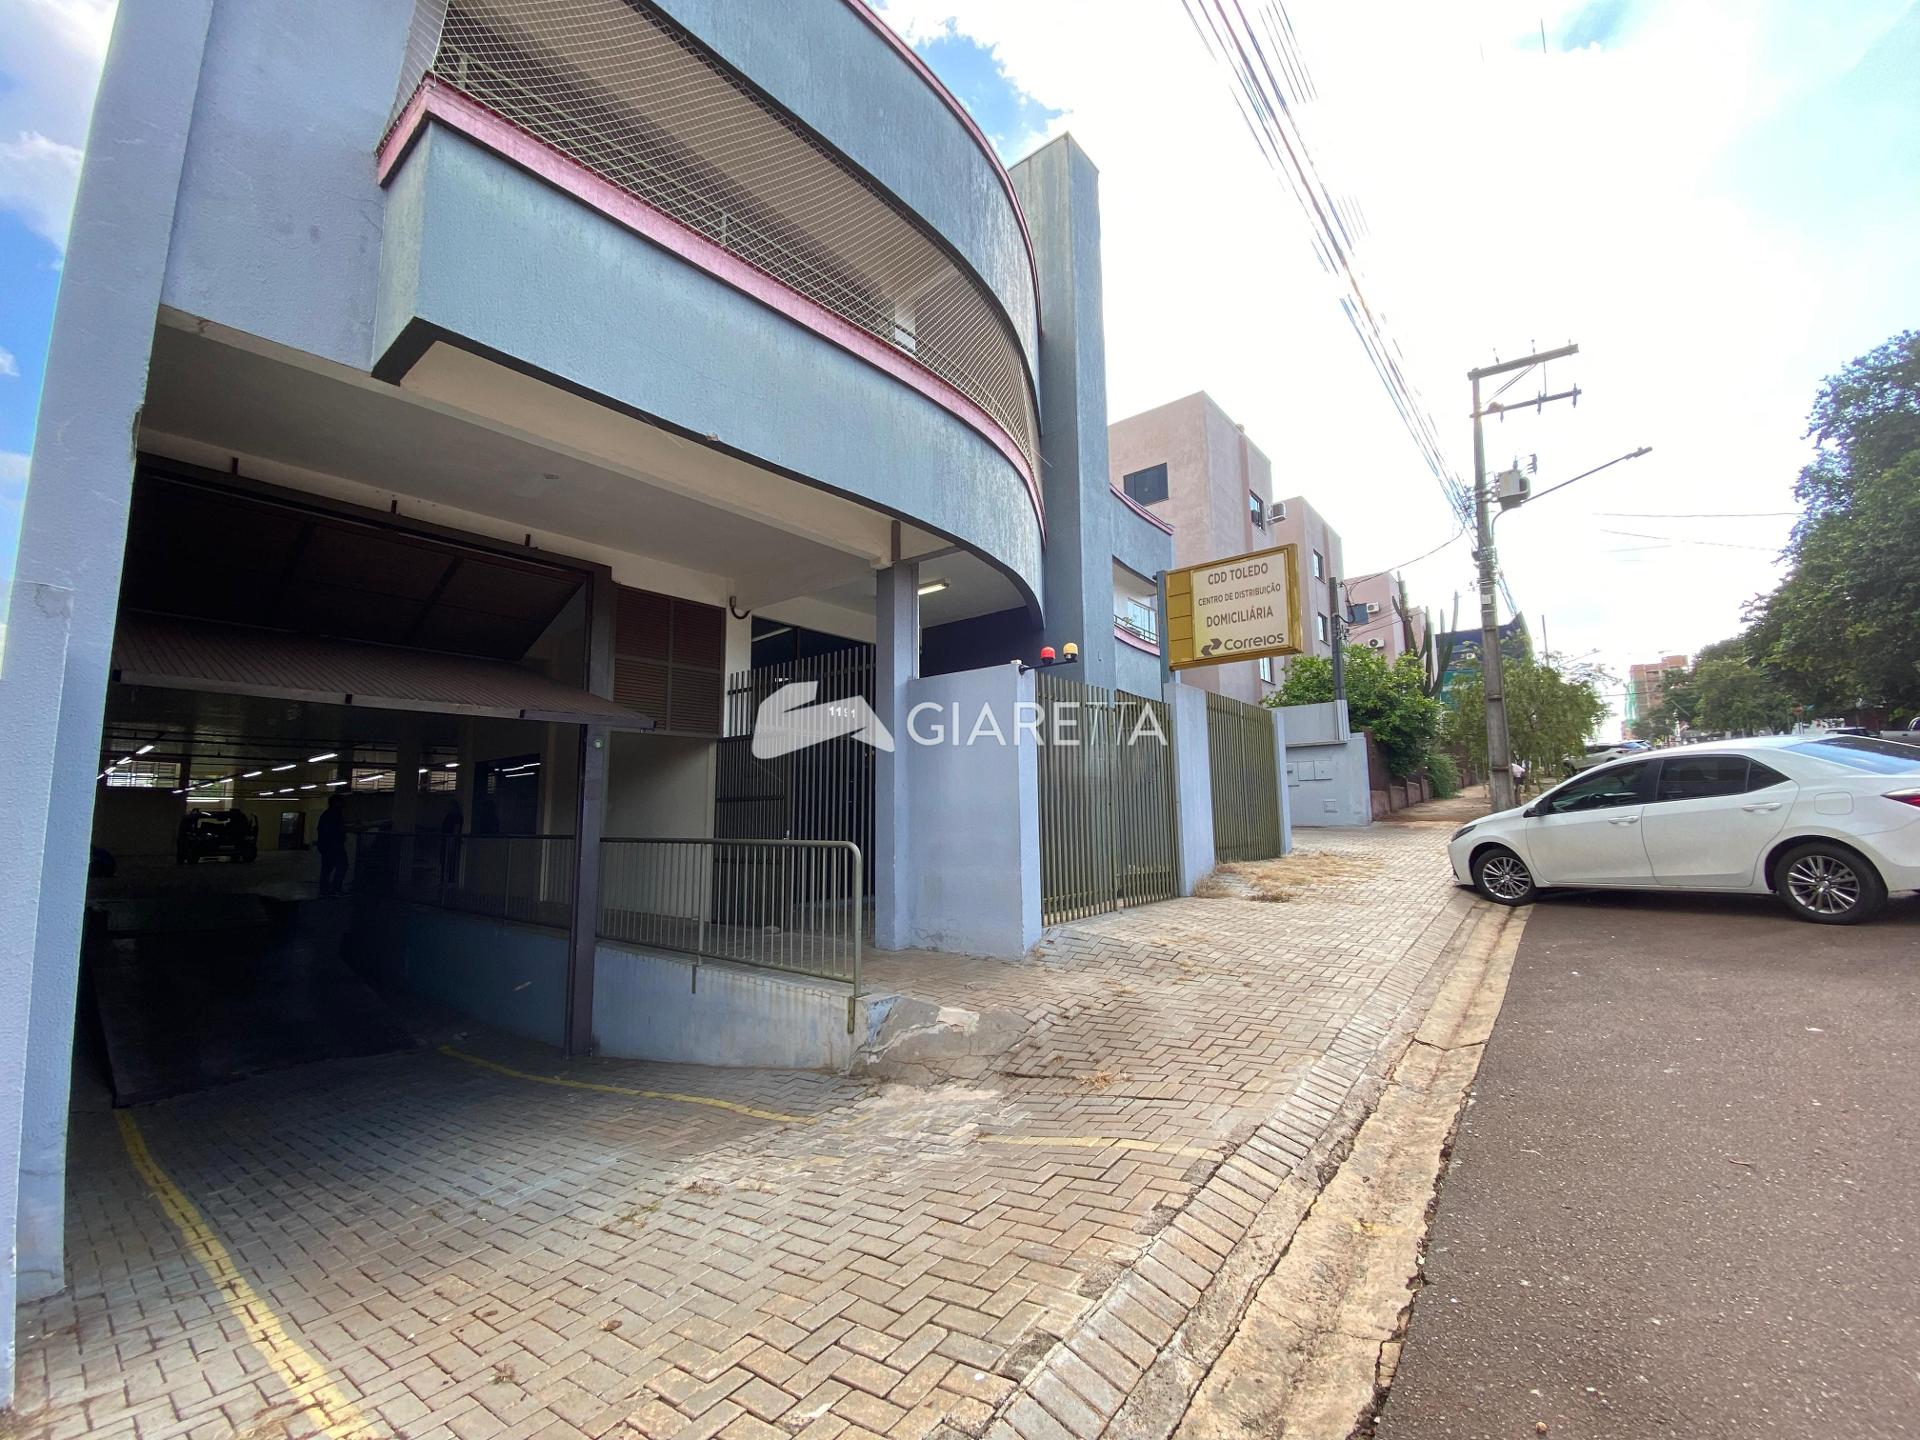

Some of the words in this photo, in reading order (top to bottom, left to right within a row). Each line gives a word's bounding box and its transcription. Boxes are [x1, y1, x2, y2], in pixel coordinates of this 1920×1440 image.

[1207, 571, 1227, 585] CDD
[1230, 562, 1268, 580] TOLEDO
[1198, 594, 1223, 606] CENTRO
[1225, 592, 1233, 601] DE
[1235, 583, 1281, 600] DISTRIBUIÇÃO
[1206, 605, 1274, 628] DOMICILIÁRIA
[1224, 633, 1284, 650] Correios
